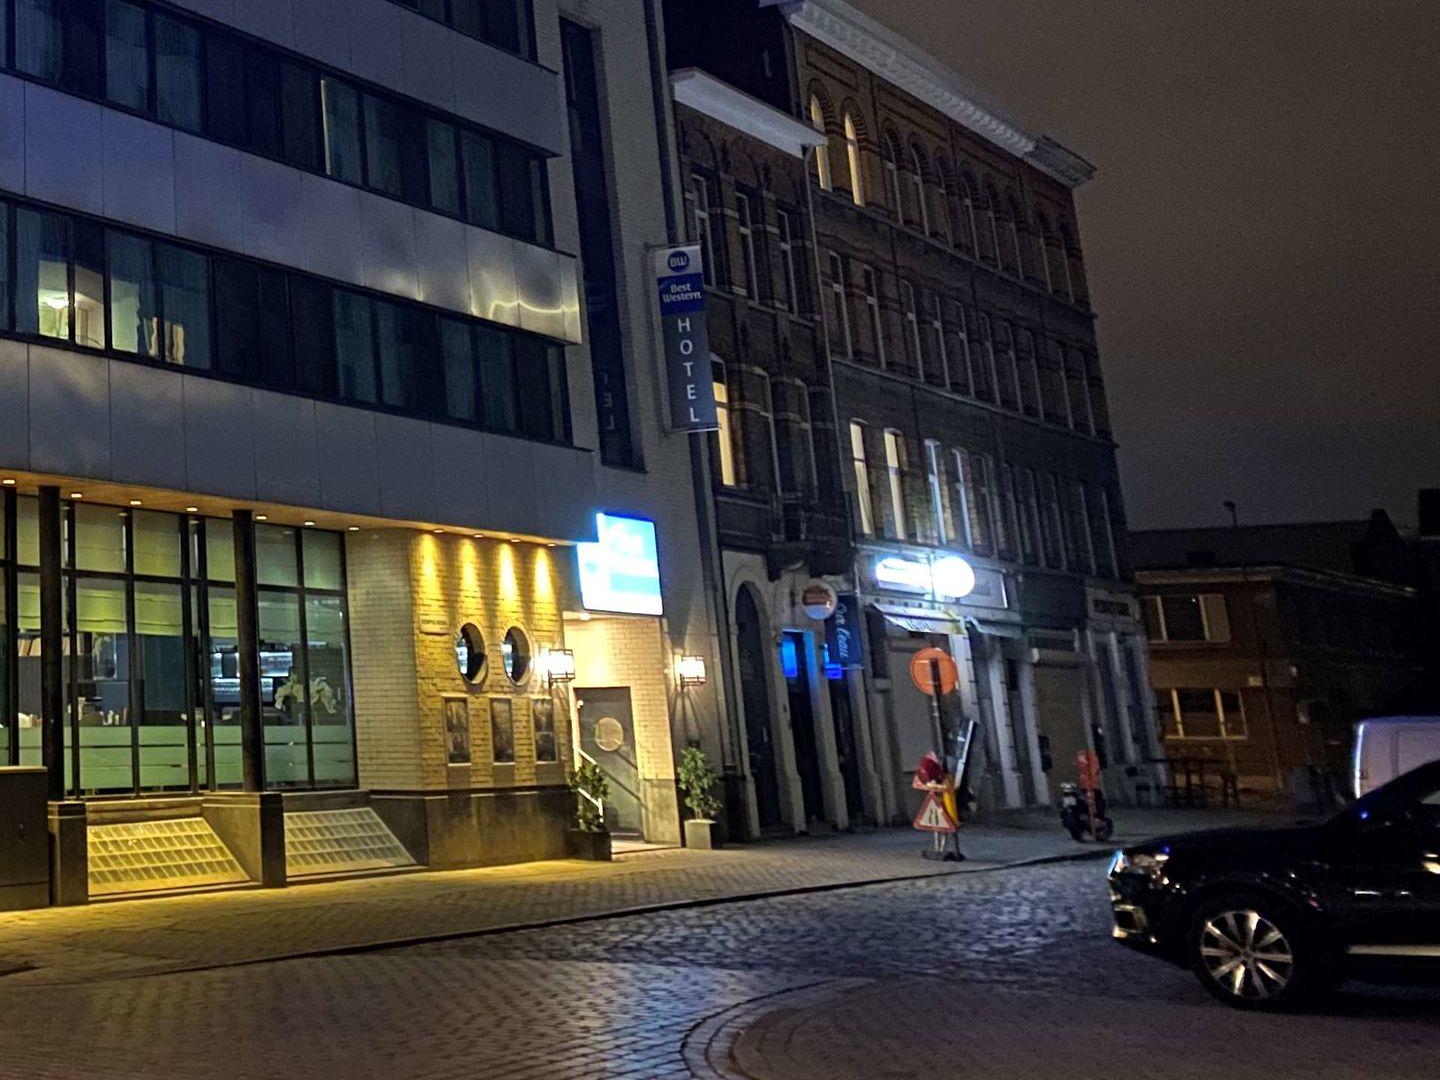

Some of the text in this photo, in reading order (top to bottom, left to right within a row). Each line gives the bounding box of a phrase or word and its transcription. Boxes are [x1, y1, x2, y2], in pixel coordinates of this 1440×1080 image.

[669, 255, 688, 268] BW
[670, 282, 691, 294] Best
[662, 290, 702, 303] Western
[677, 317, 700, 423] HOTEL
